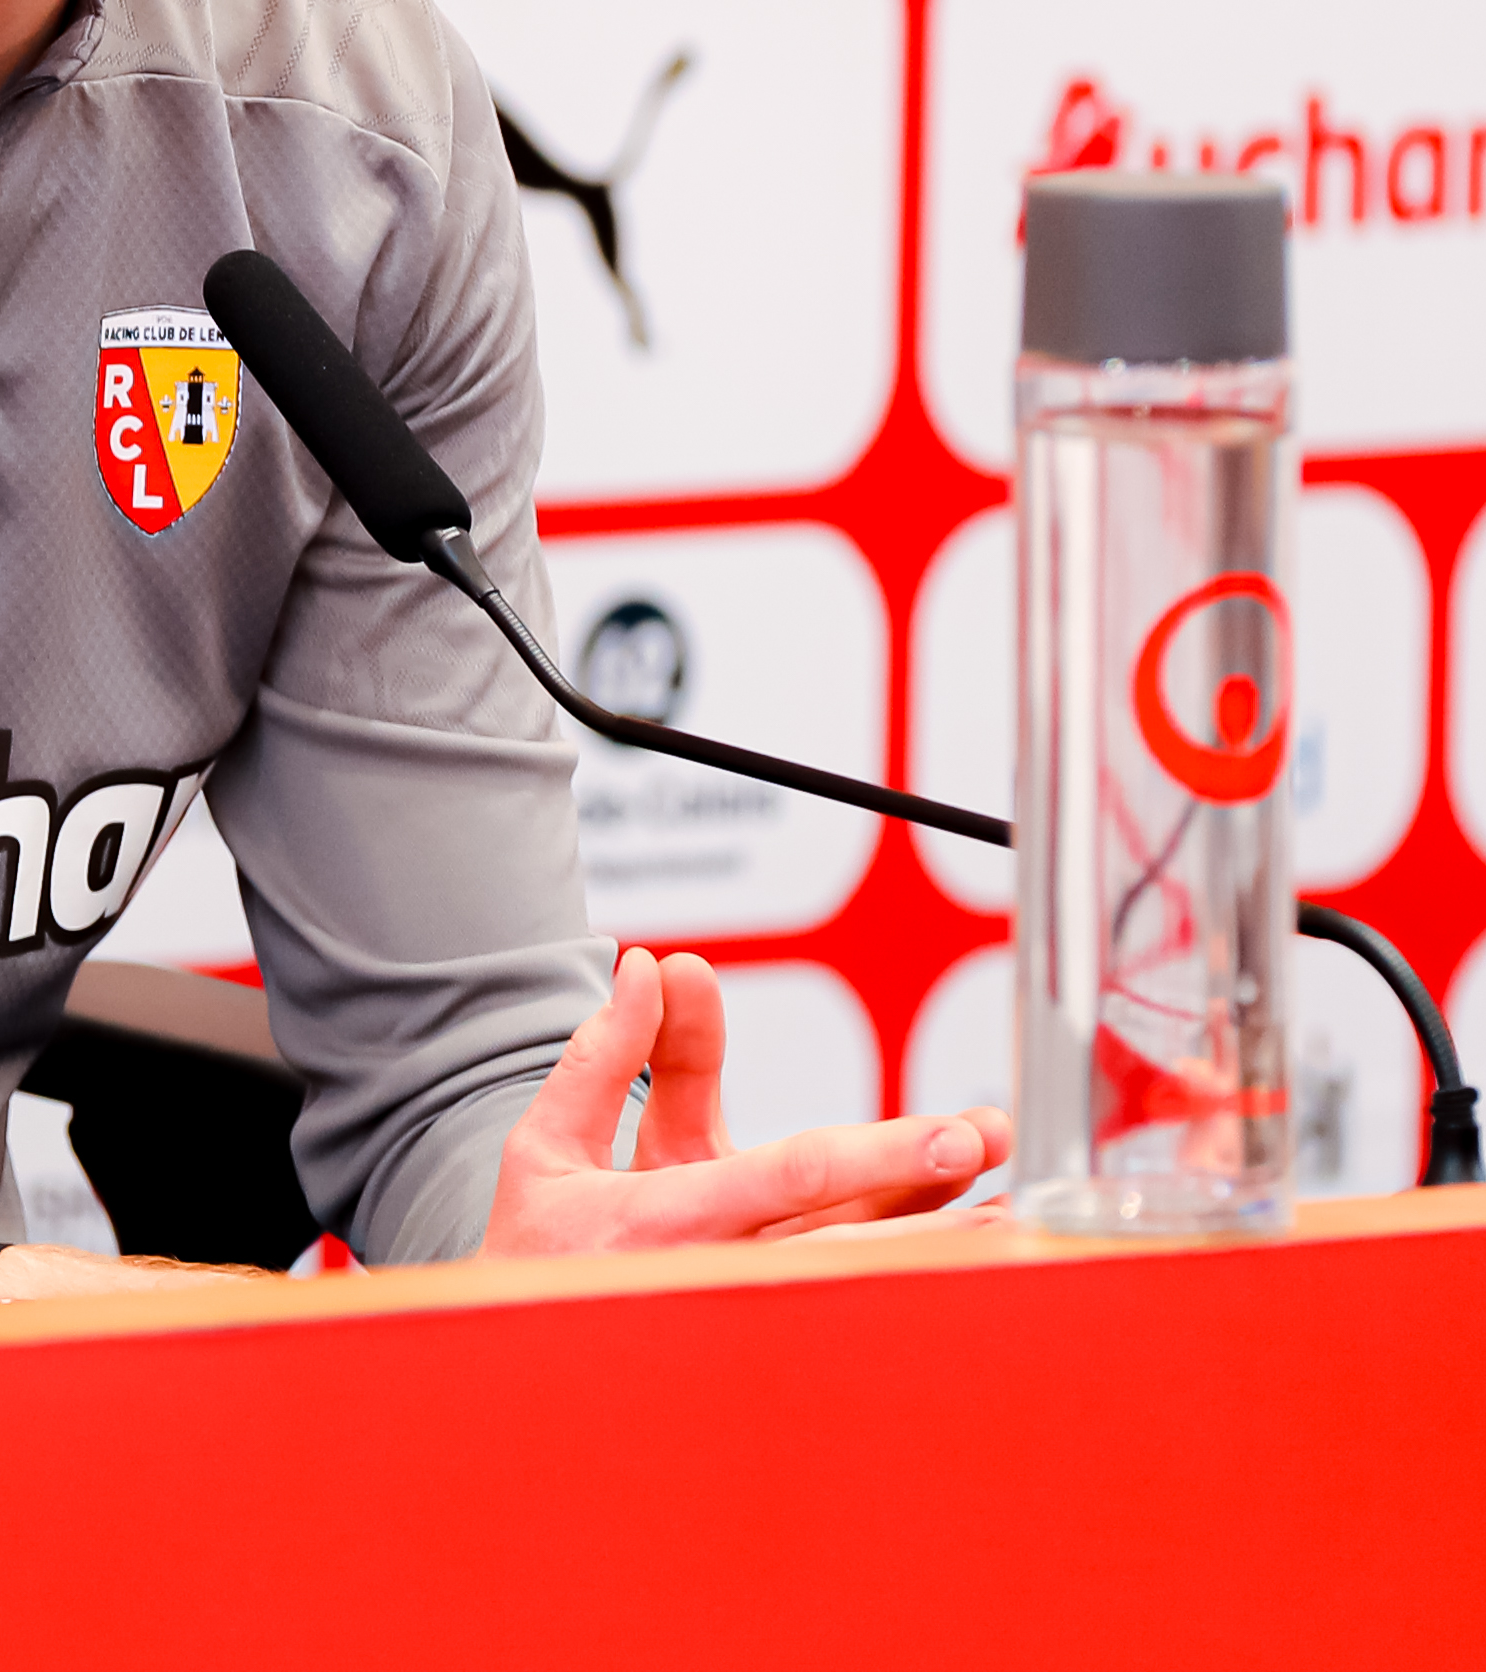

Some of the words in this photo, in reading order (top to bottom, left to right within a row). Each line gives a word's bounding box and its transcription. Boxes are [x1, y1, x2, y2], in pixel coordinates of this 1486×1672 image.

[104, 326, 140, 341] RACING
[143, 327, 175, 341] CLUB
[179, 328, 195, 340] DE
[199, 328, 226, 341] LEN
